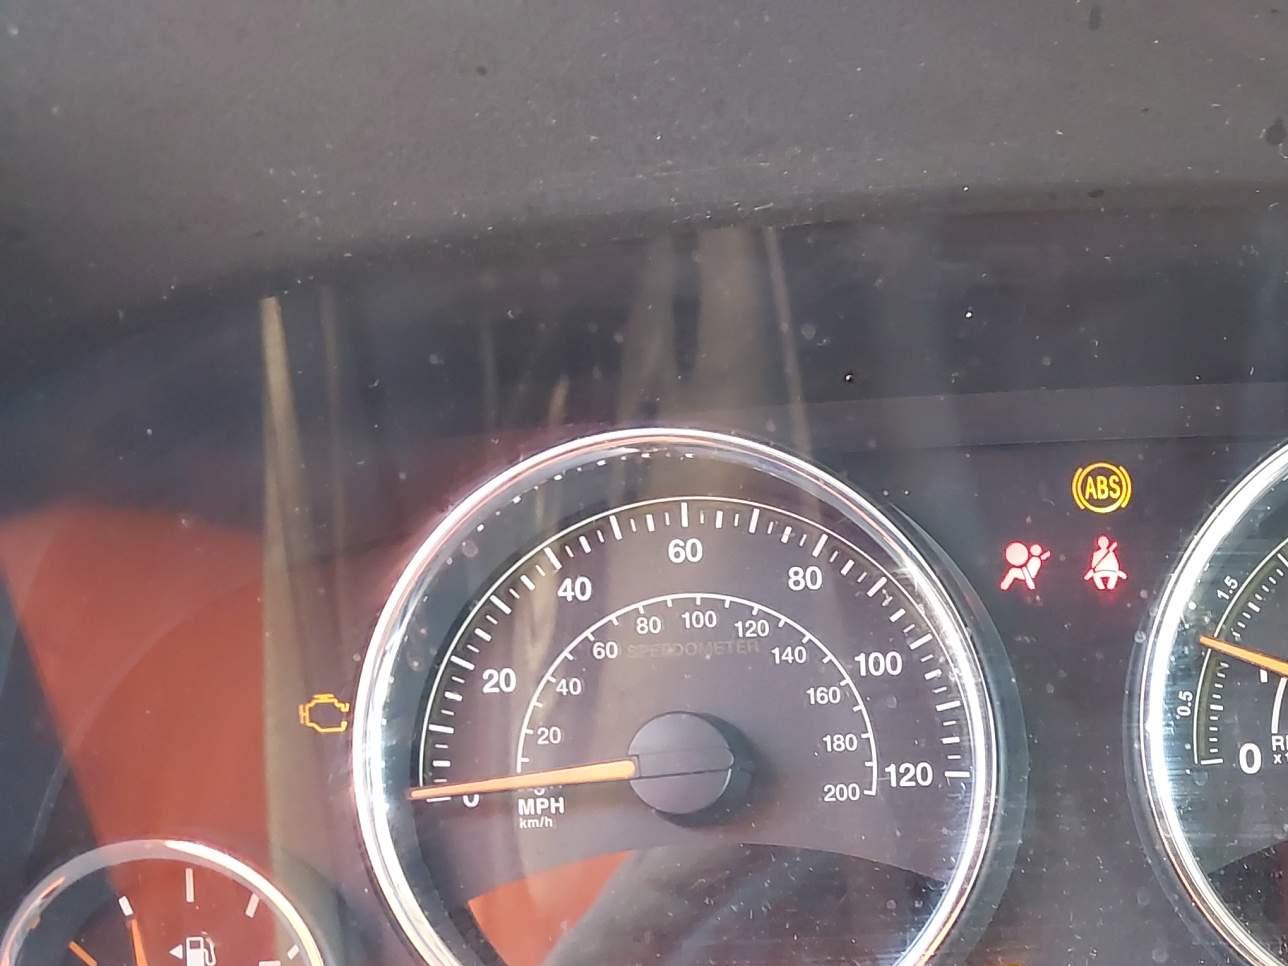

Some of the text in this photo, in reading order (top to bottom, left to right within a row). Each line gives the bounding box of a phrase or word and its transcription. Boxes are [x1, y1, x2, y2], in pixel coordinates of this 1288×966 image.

[1085, 475, 1121, 499] ABS
[668, 538, 703, 563] 60
[788, 566, 822, 591] 80
[1216, 576, 1238, 600] 1.5
[557, 576, 592, 602] 40
[636, 616, 662, 634] 80
[682, 611, 717, 629] 100
[735, 619, 769, 638] 120
[592, 641, 618, 659] 60
[771, 646, 807, 664] 140
[854, 651, 902, 676] 100
[482, 668, 516, 693] 20
[556, 678, 582, 695] 40
[806, 687, 841, 705] 160
[1177, 690, 1193, 717] 0.5
[537, 727, 561, 744] 20
[823, 734, 857, 752] 180
[1239, 743, 1262, 774] 0
[885, 762, 932, 787] 120
[823, 783, 860, 802] 200
[517, 796, 565, 815] MPH
[519, 816, 553, 829] km/h
